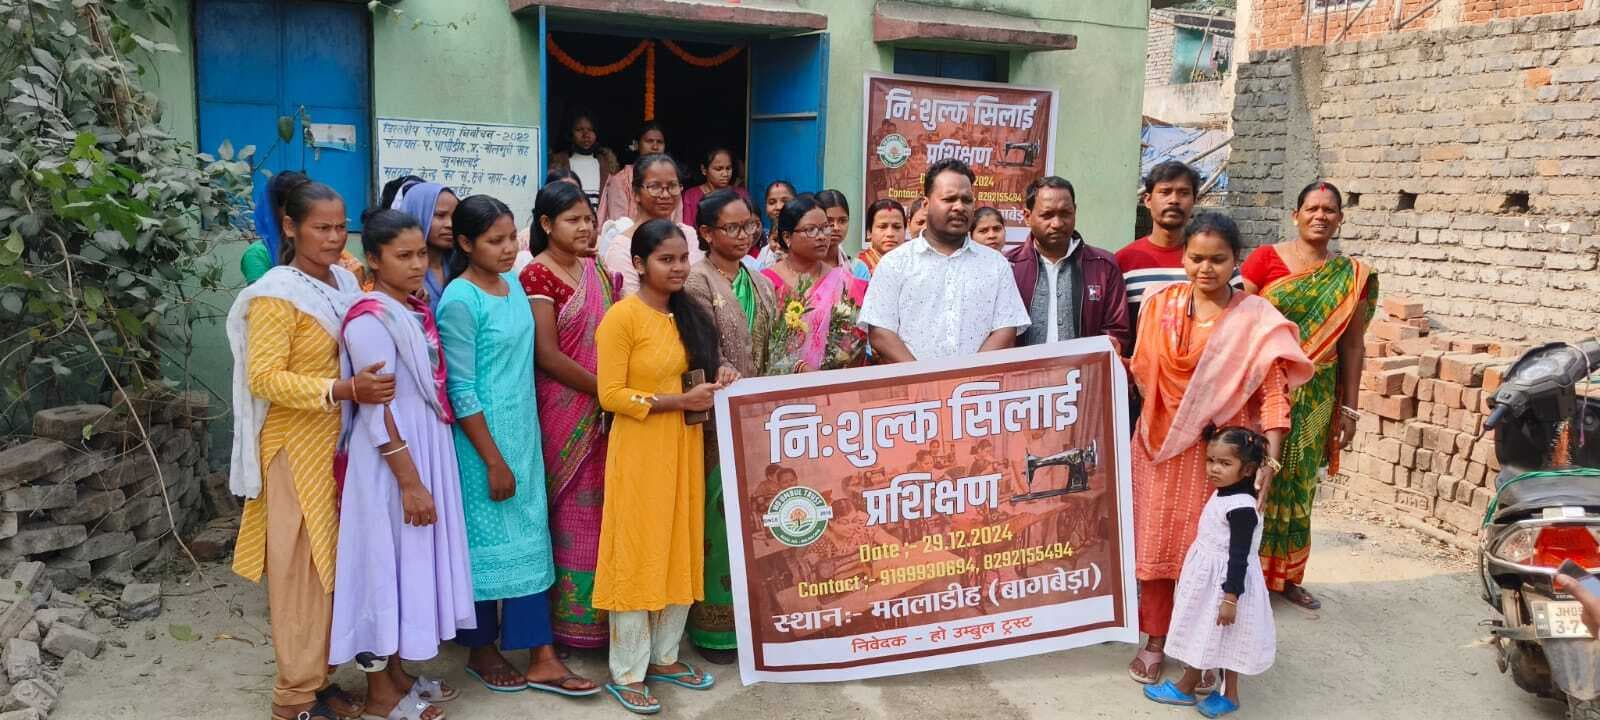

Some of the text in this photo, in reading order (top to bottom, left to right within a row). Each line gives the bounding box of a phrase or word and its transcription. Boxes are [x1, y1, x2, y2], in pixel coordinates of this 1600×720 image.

[973, 95, 1037, 130] सिलाई
[947, 369, 1082, 442] सिलाई
[863, 472, 1002, 527] प्रशिक्षण
[798, 574, 860, 598] Contact
[983, 542, 1073, 570] 8292155494
[859, 542, 899, 563] Date
[922, 523, 1013, 553] 29.12.2024
[870, 582, 982, 620] मतलाडीह
[988, 562, 1102, 607] (बागबेड़ा)
[851, 634, 908, 653] निवेदक
[929, 626, 946, 643] हो
[953, 622, 996, 640] उम्बुल
[1001, 615, 1033, 635] ट्रस्ट
